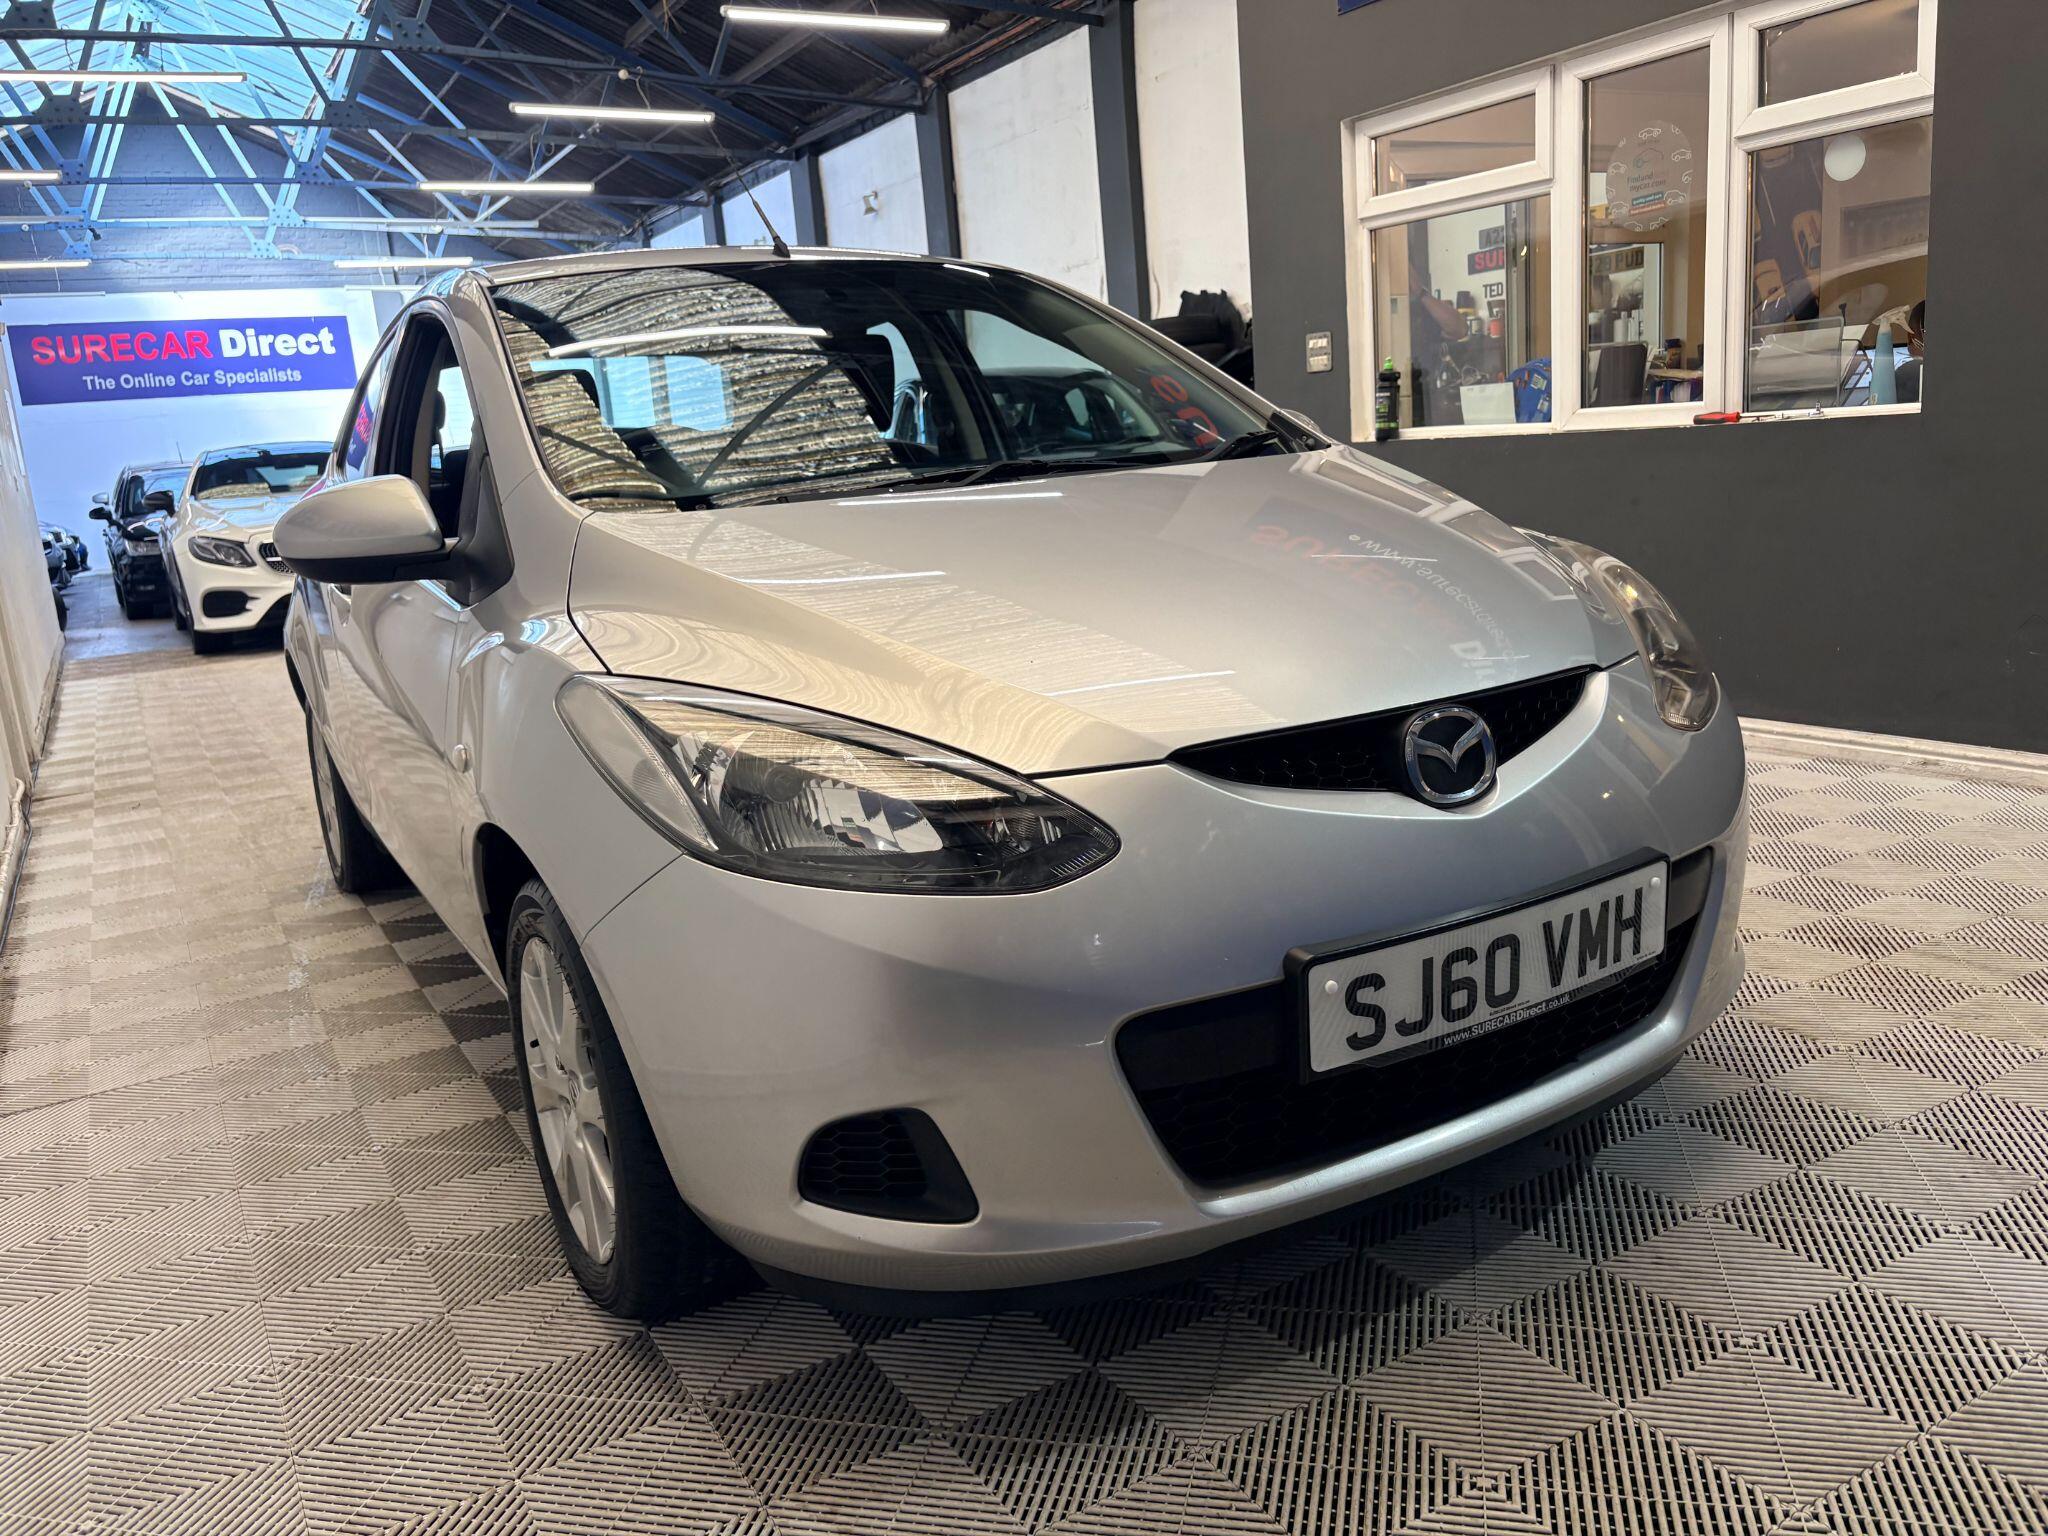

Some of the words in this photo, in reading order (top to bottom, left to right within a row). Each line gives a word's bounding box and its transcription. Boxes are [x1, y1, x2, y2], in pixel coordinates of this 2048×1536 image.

[31, 330, 213, 366] SURECAR
[218, 326, 336, 358] Direct
[82, 375, 116, 391] The
[120, 372, 176, 389] Online
[181, 370, 210, 386] Car
[214, 367, 302, 387] Specialists
[1345, 933, 1520, 1051] SJ60
[1542, 887, 1643, 988] VMH
[1443, 993, 1571, 1046] www.SURECARDirect.co.uk
